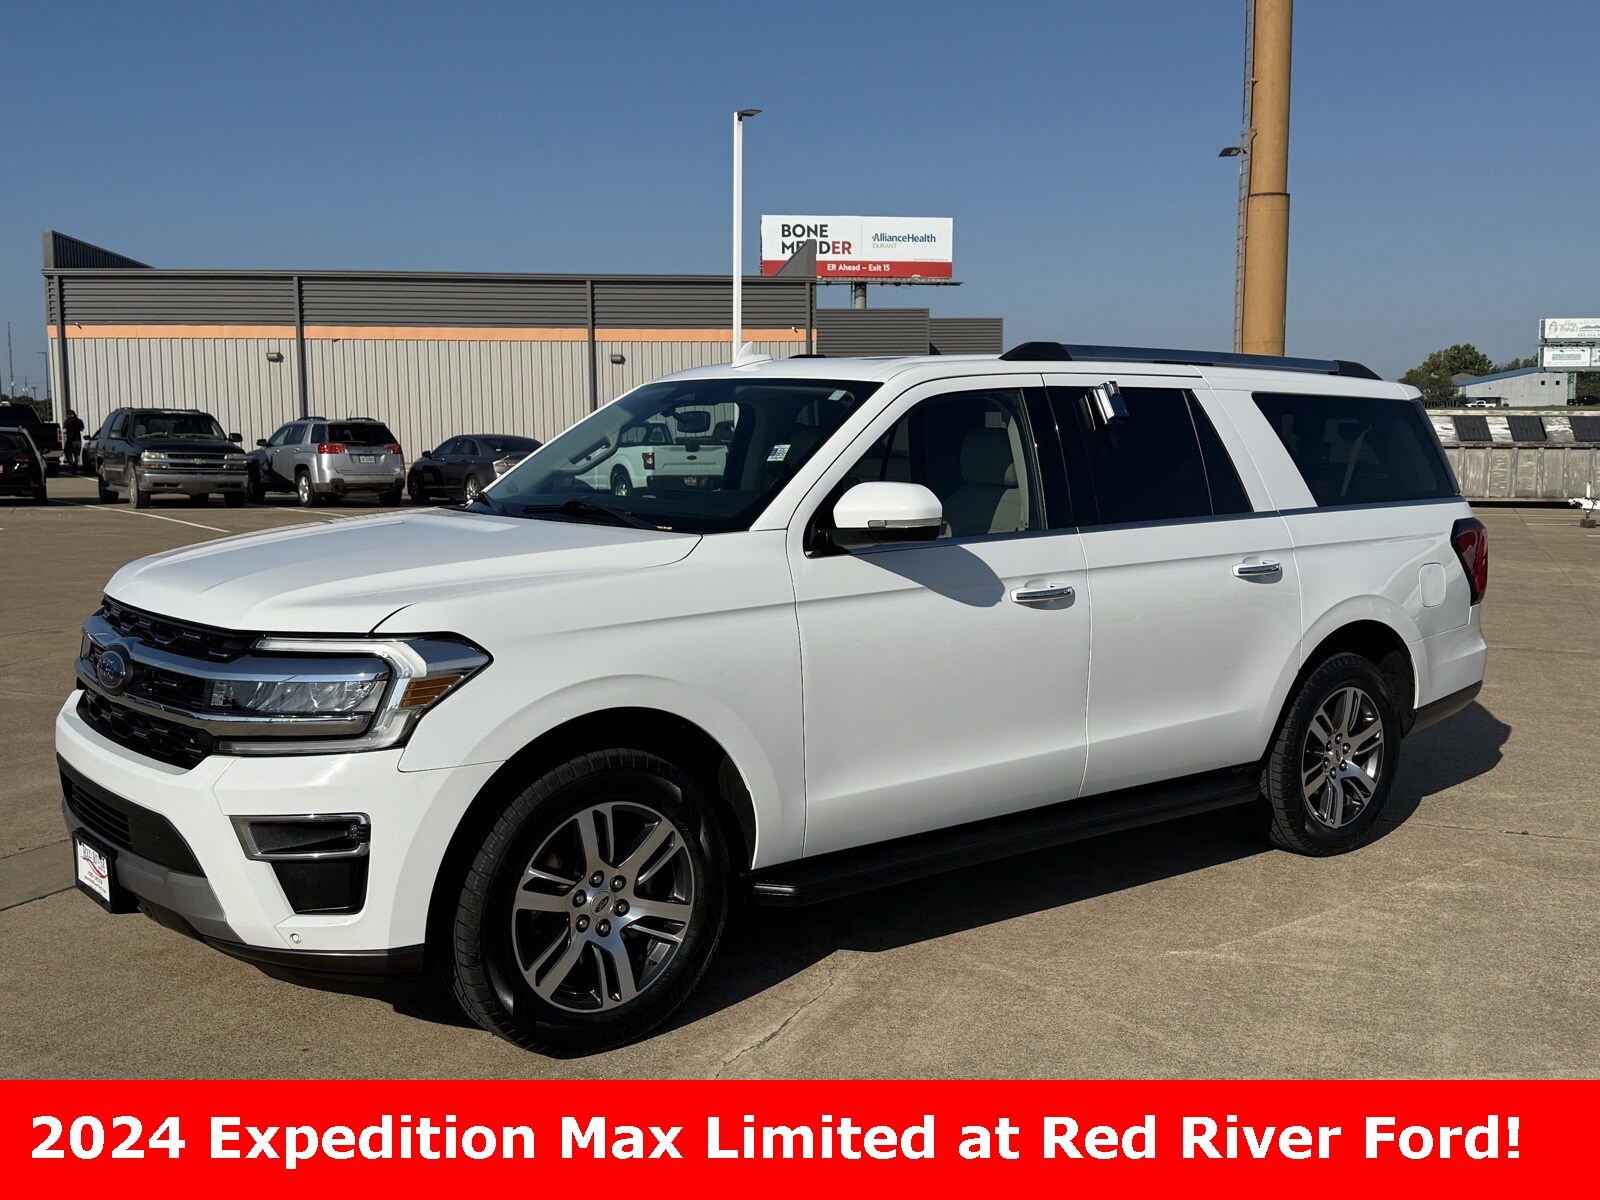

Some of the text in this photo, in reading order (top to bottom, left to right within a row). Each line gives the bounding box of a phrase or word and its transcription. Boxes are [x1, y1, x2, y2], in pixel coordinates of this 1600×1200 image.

[781, 223, 829, 238] BONE
[872, 232, 936, 243] AllianceHealth
[781, 240, 852, 255] MDER
[827, 263, 837, 271] ER
[838, 263, 861, 271] Ahead
[868, 263, 882, 272] Exit
[883, 264, 891, 272] 15
